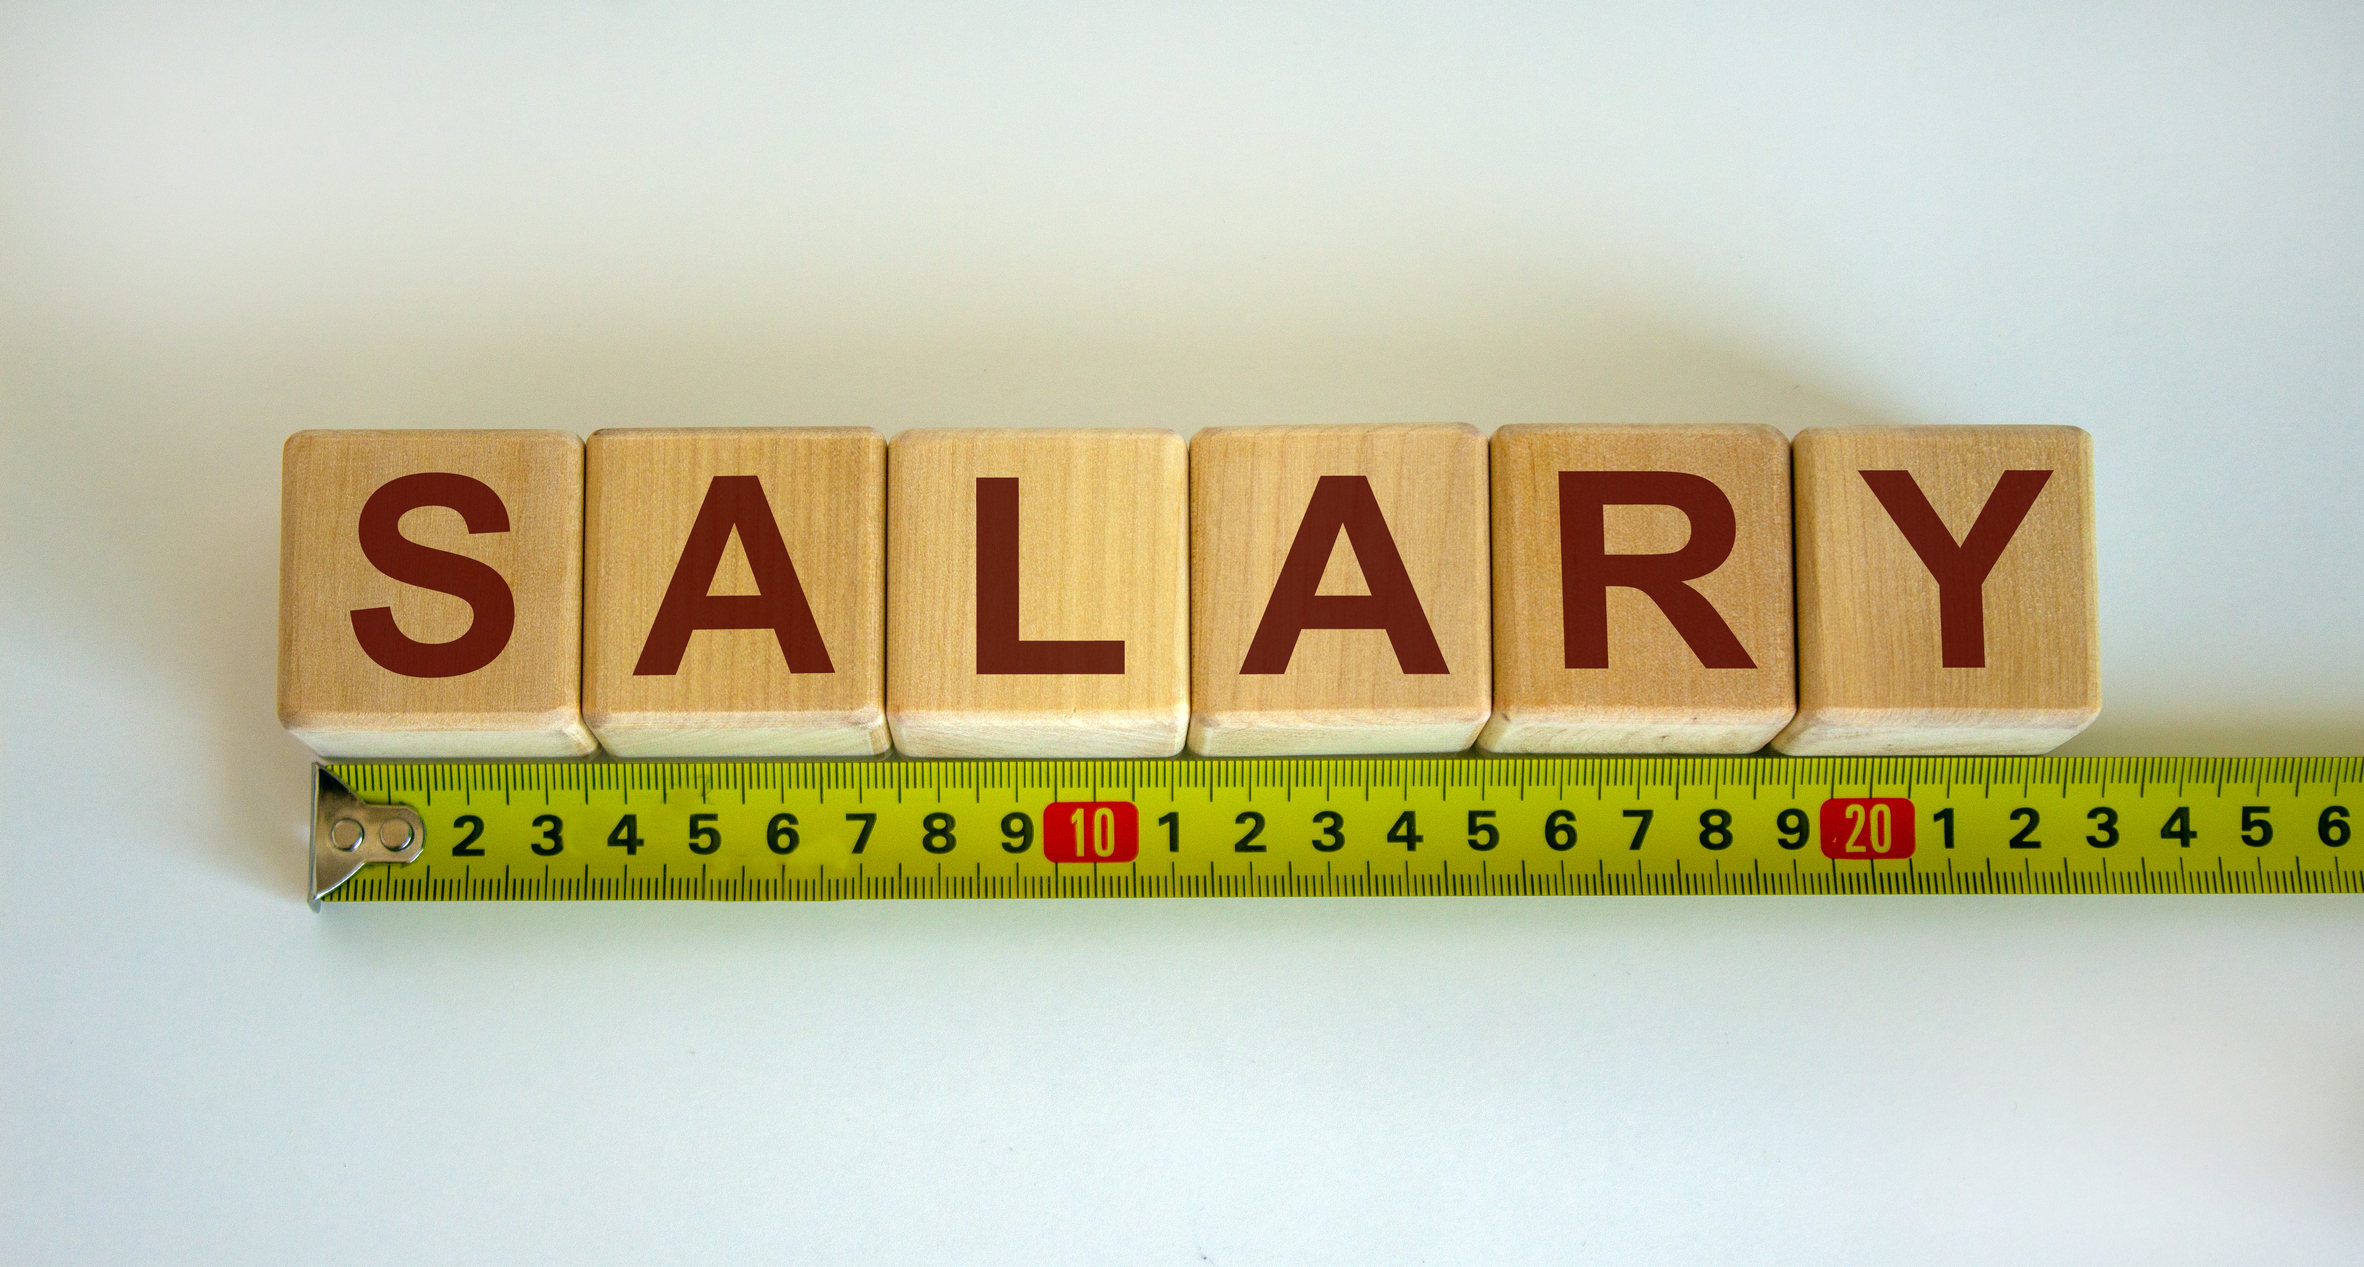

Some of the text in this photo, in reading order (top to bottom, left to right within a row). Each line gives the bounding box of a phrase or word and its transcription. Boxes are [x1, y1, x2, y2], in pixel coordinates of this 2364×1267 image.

[349, 469, 2054, 679] SALARY
[451, 803, 2352, 858] 2 3 4 5 6 7 8 9 10 1 2 3 4 5 6 7 8 9 20 1 2 3 4 5 6
